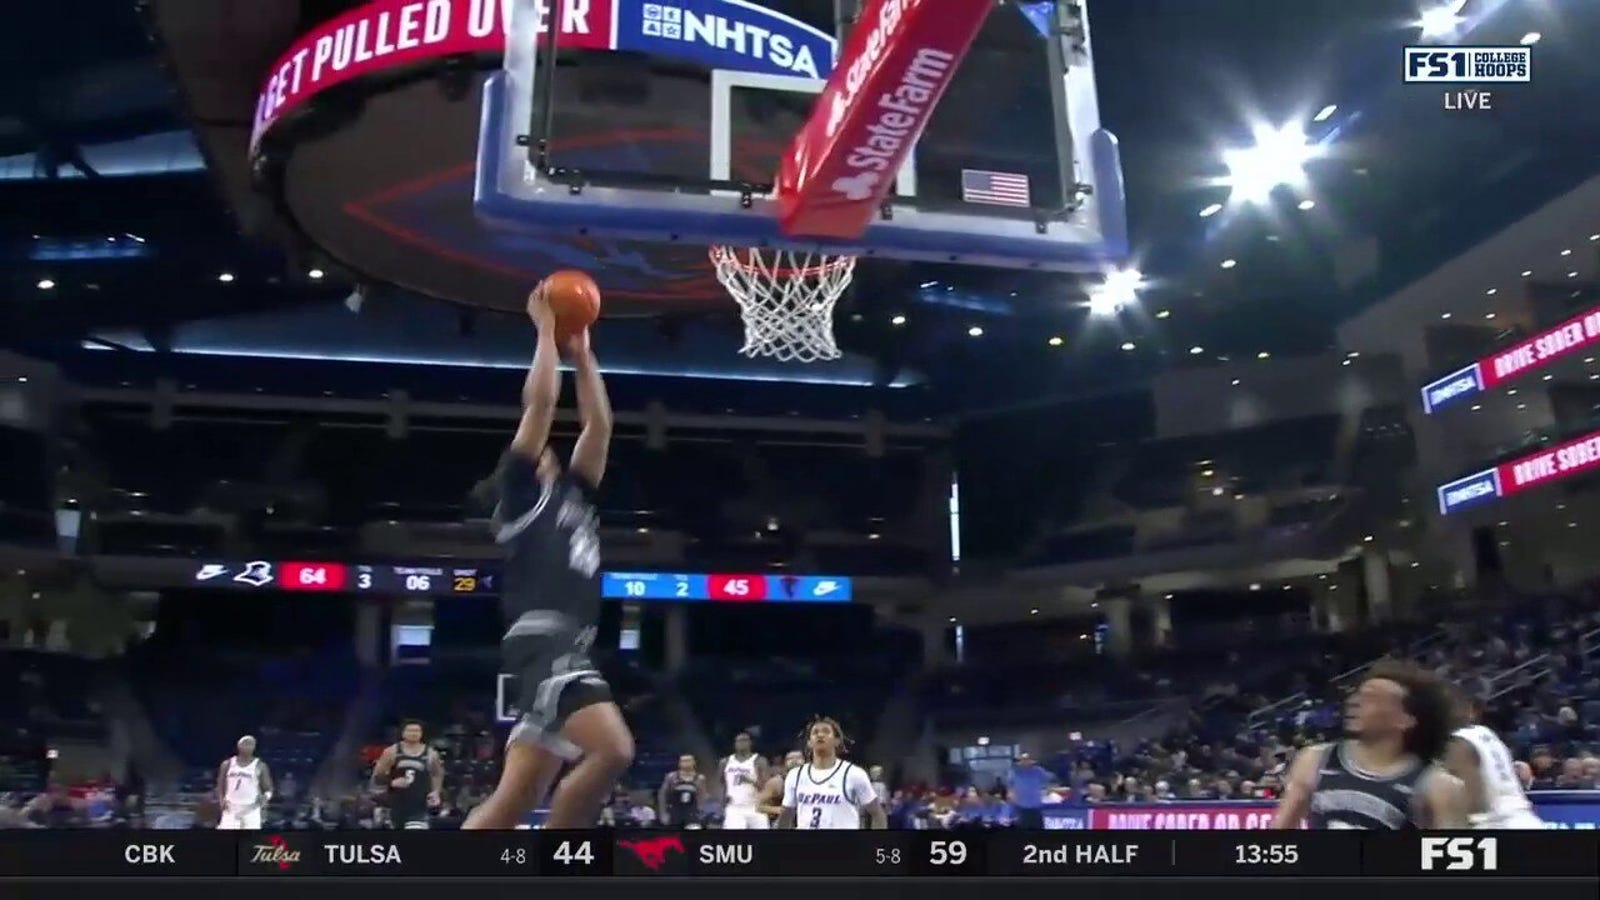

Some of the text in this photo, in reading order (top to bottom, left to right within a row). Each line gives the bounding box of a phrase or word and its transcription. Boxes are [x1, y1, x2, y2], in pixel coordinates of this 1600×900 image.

[679, 12, 819, 79] NHTSA
[263, 48, 309, 119] GET
[311, 0, 453, 82] PULLED
[299, 568, 327, 585] 64
[357, 573, 372, 589] 3
[405, 575, 431, 591] 06
[453, 577, 477, 592] 29
[624, 581, 646, 596] 10
[675, 582, 690, 597] 2
[723, 579, 750, 596] 45
[809, 806, 823, 828] 3
